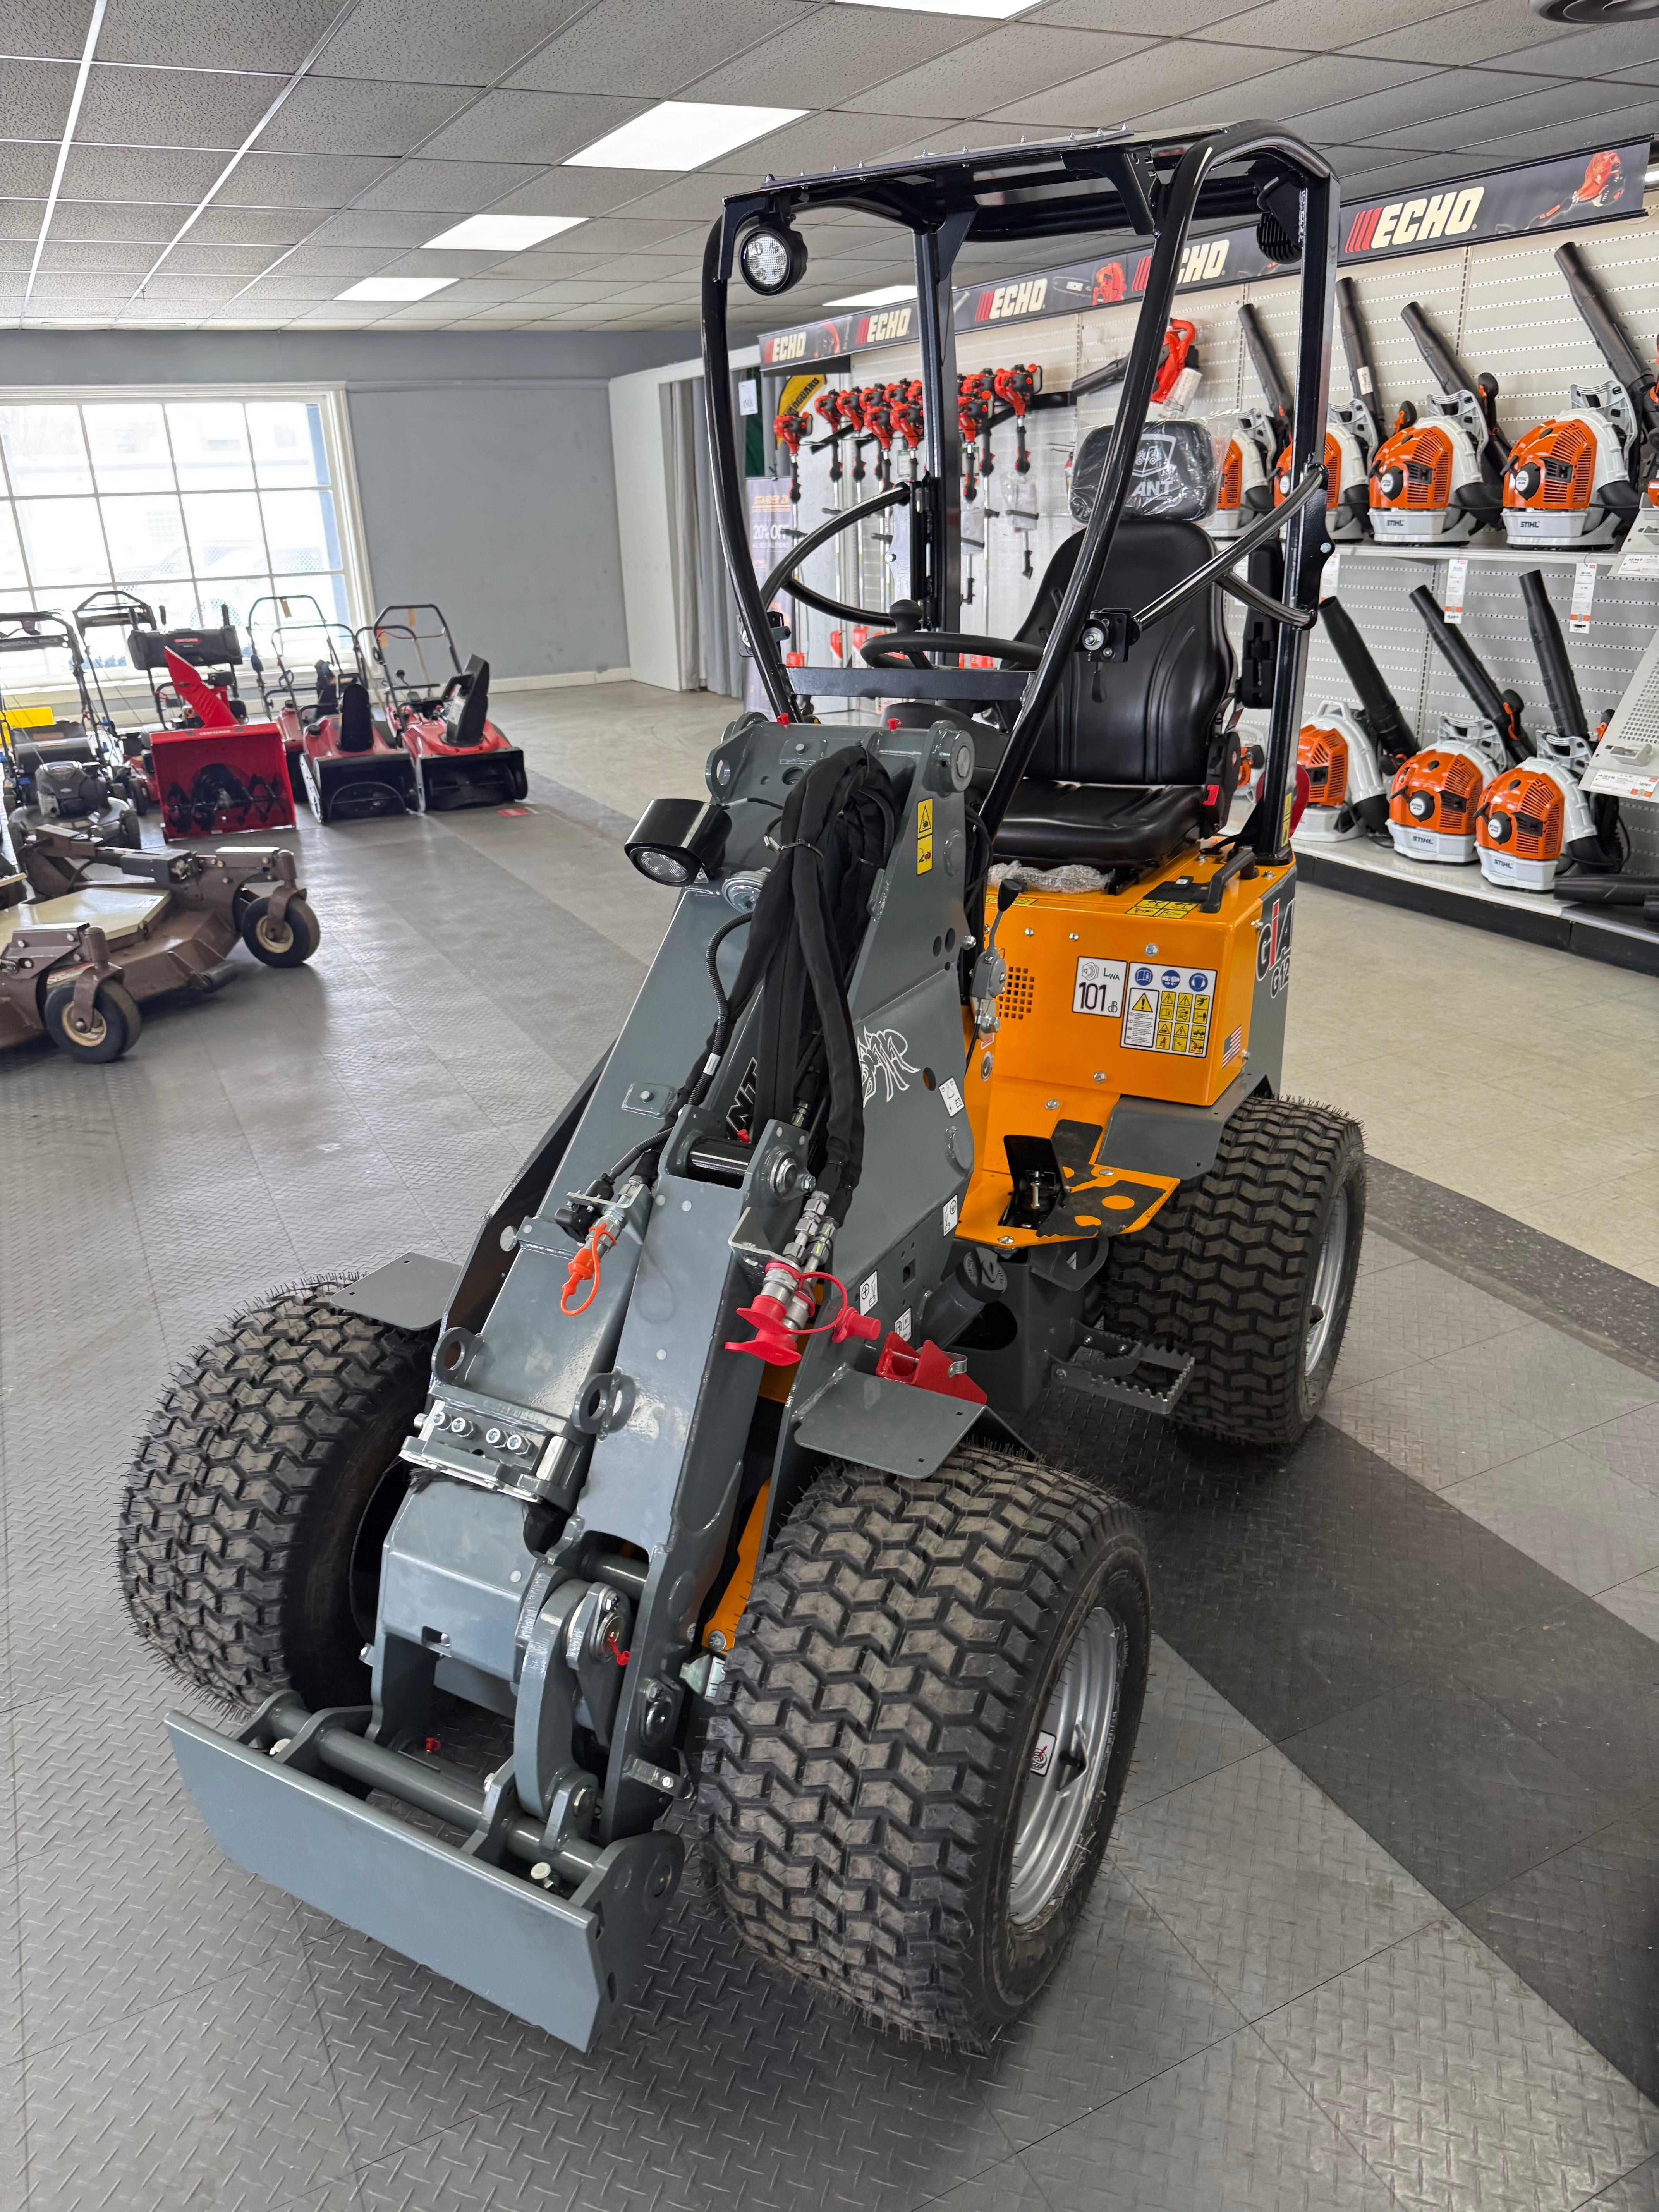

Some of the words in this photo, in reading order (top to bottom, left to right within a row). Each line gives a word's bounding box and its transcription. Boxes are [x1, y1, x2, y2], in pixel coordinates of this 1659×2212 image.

[1371, 186, 1484, 248] ECHO
[989, 278, 1047, 319] ECHO
[867, 308, 910, 342] ECHO
[772, 332, 807, 362] ECHO
[1412, 836, 1434, 845] STIHL
[1494, 859, 1513, 869] STIHL
[1079, 982, 1107, 1012] 101
[1108, 1001, 1118, 1013] dB
